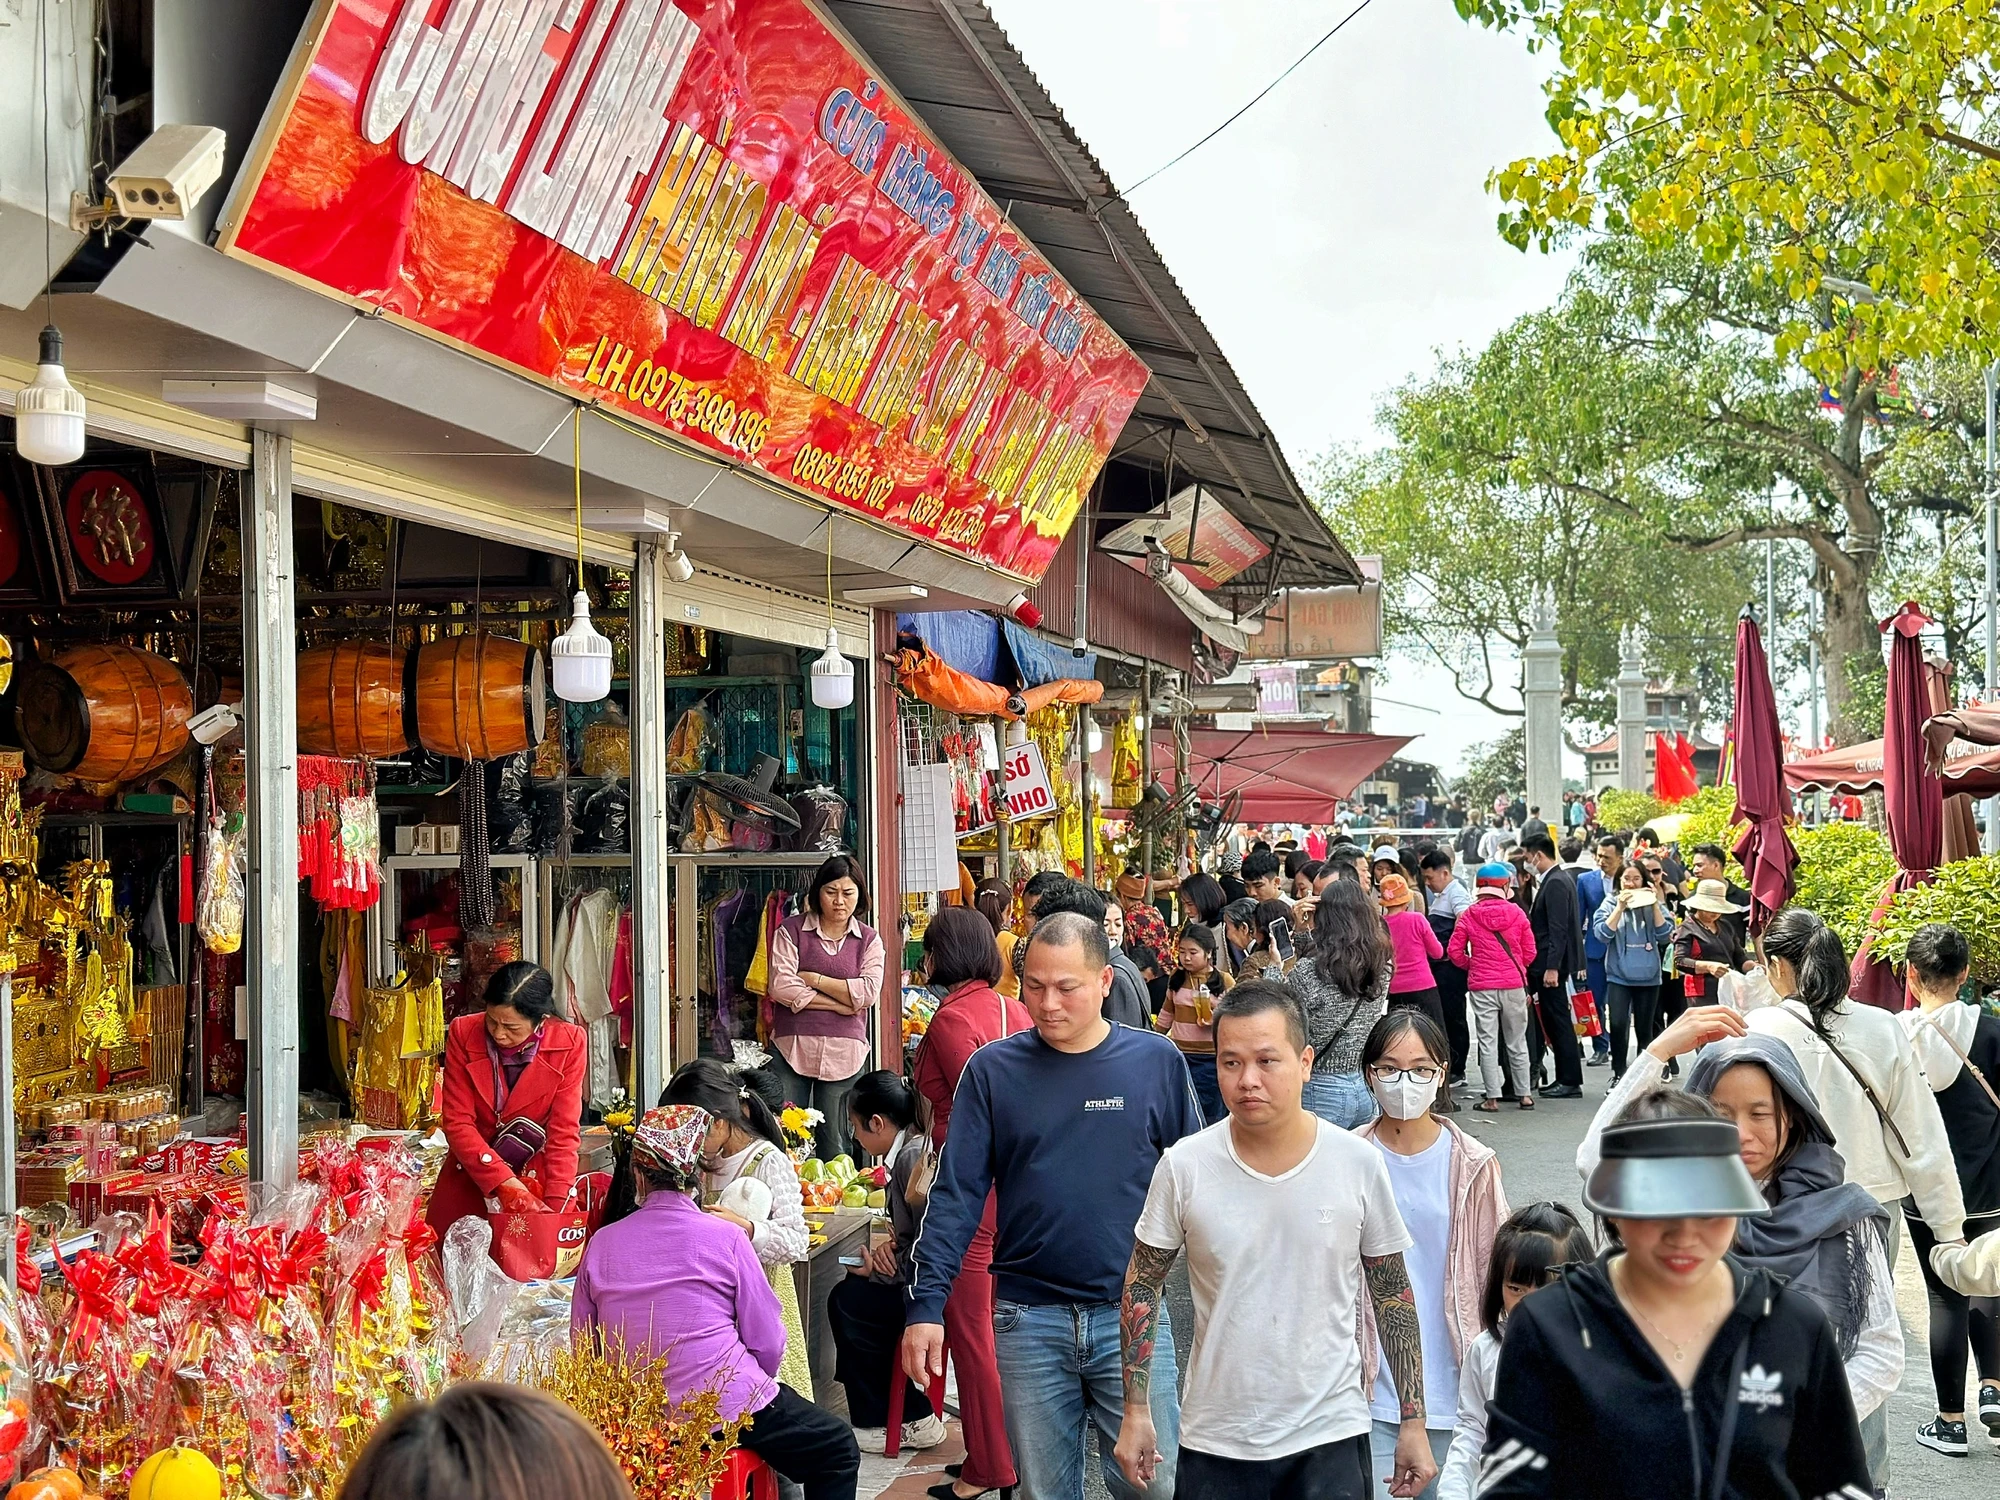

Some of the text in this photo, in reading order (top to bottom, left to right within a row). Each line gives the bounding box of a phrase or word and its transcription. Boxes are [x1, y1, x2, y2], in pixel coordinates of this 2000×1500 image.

[820, 79, 886, 177] CỬA
[876, 143, 955, 237] HÀNG
[948, 211, 990, 282] TỰ
[975, 241, 1029, 299] KHÍ
[610, 115, 767, 331] HÀNG
[720, 202, 836, 364] MÃ
[686, 387, 736, 438] 399
[729, 408, 772, 454] 196
[791, 443, 894, 511] 0862 859 102
[908, 492, 945, 529] 0372
[1085, 1098, 1124, 1108] ATHLETIC
[558, 1226, 587, 1242] COS
